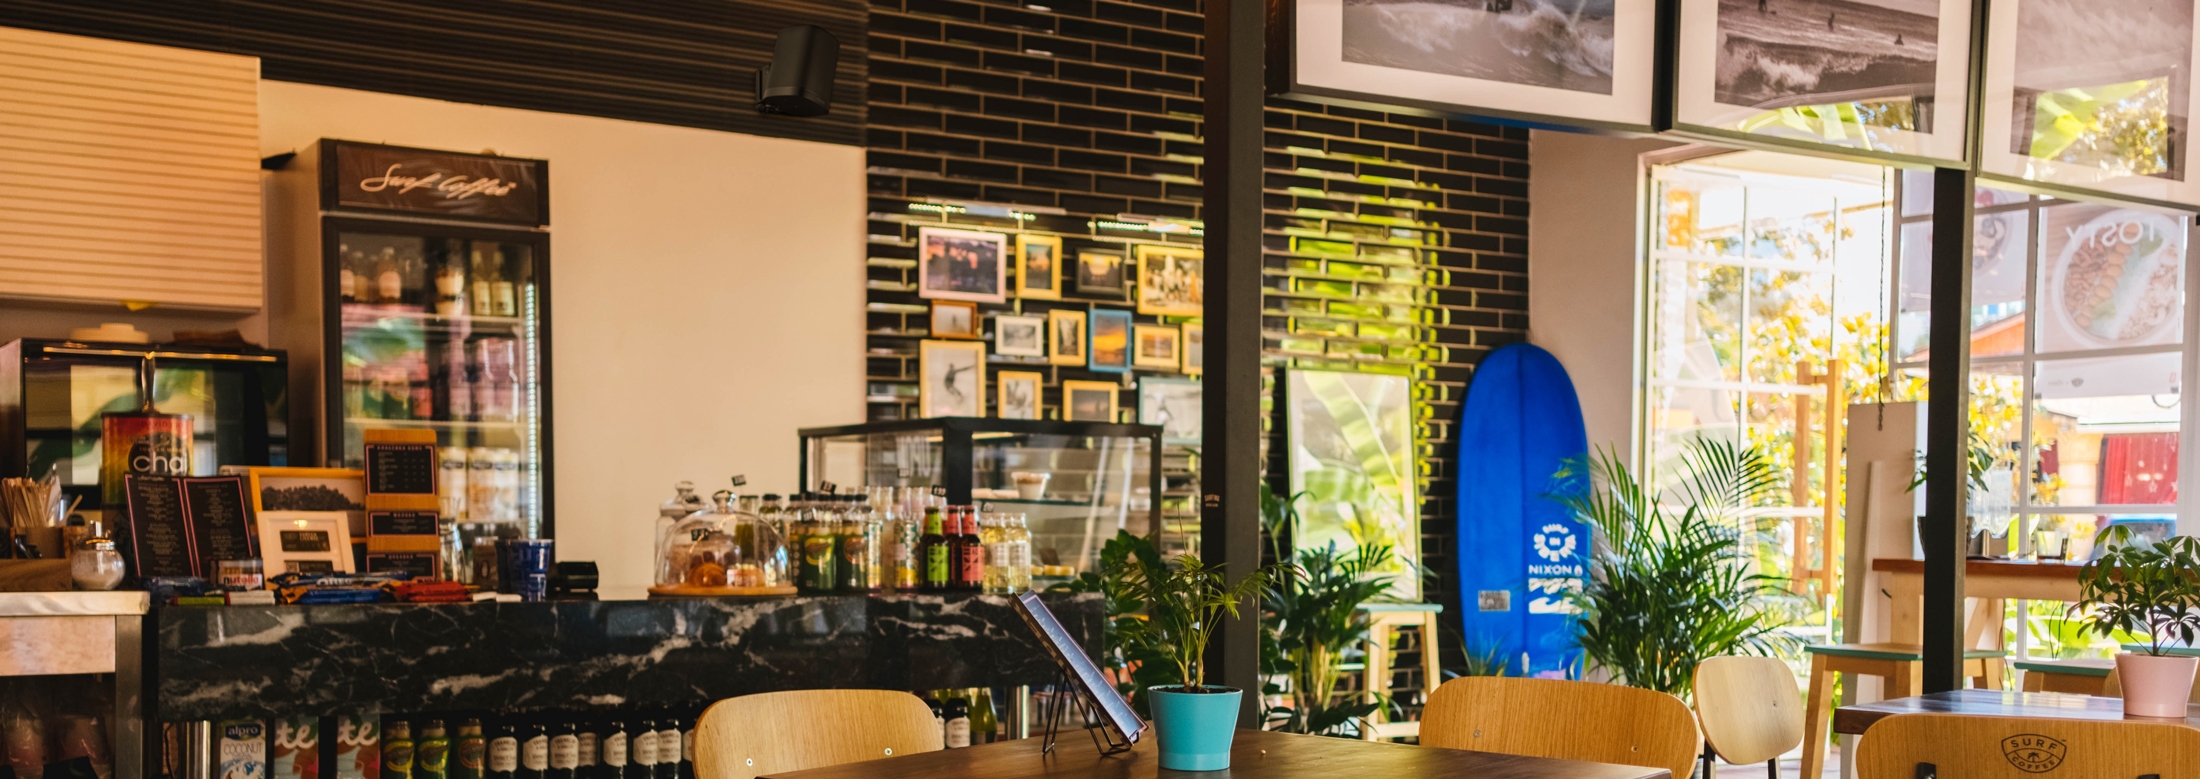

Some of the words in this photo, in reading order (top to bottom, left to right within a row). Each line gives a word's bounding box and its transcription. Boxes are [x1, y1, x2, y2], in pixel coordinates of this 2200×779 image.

[360, 163, 442, 195] Surf
[437, 175, 511, 200] Coffee
[133, 450, 187, 473] chai
[1528, 564, 1572, 575] NIXON
[223, 573, 259, 584] nutella
[228, 725, 259, 738] alpro
[223, 742, 263, 756] COCONUT
[2010, 738, 2058, 750] SURF
[2011, 756, 2056, 770] COFFEE
